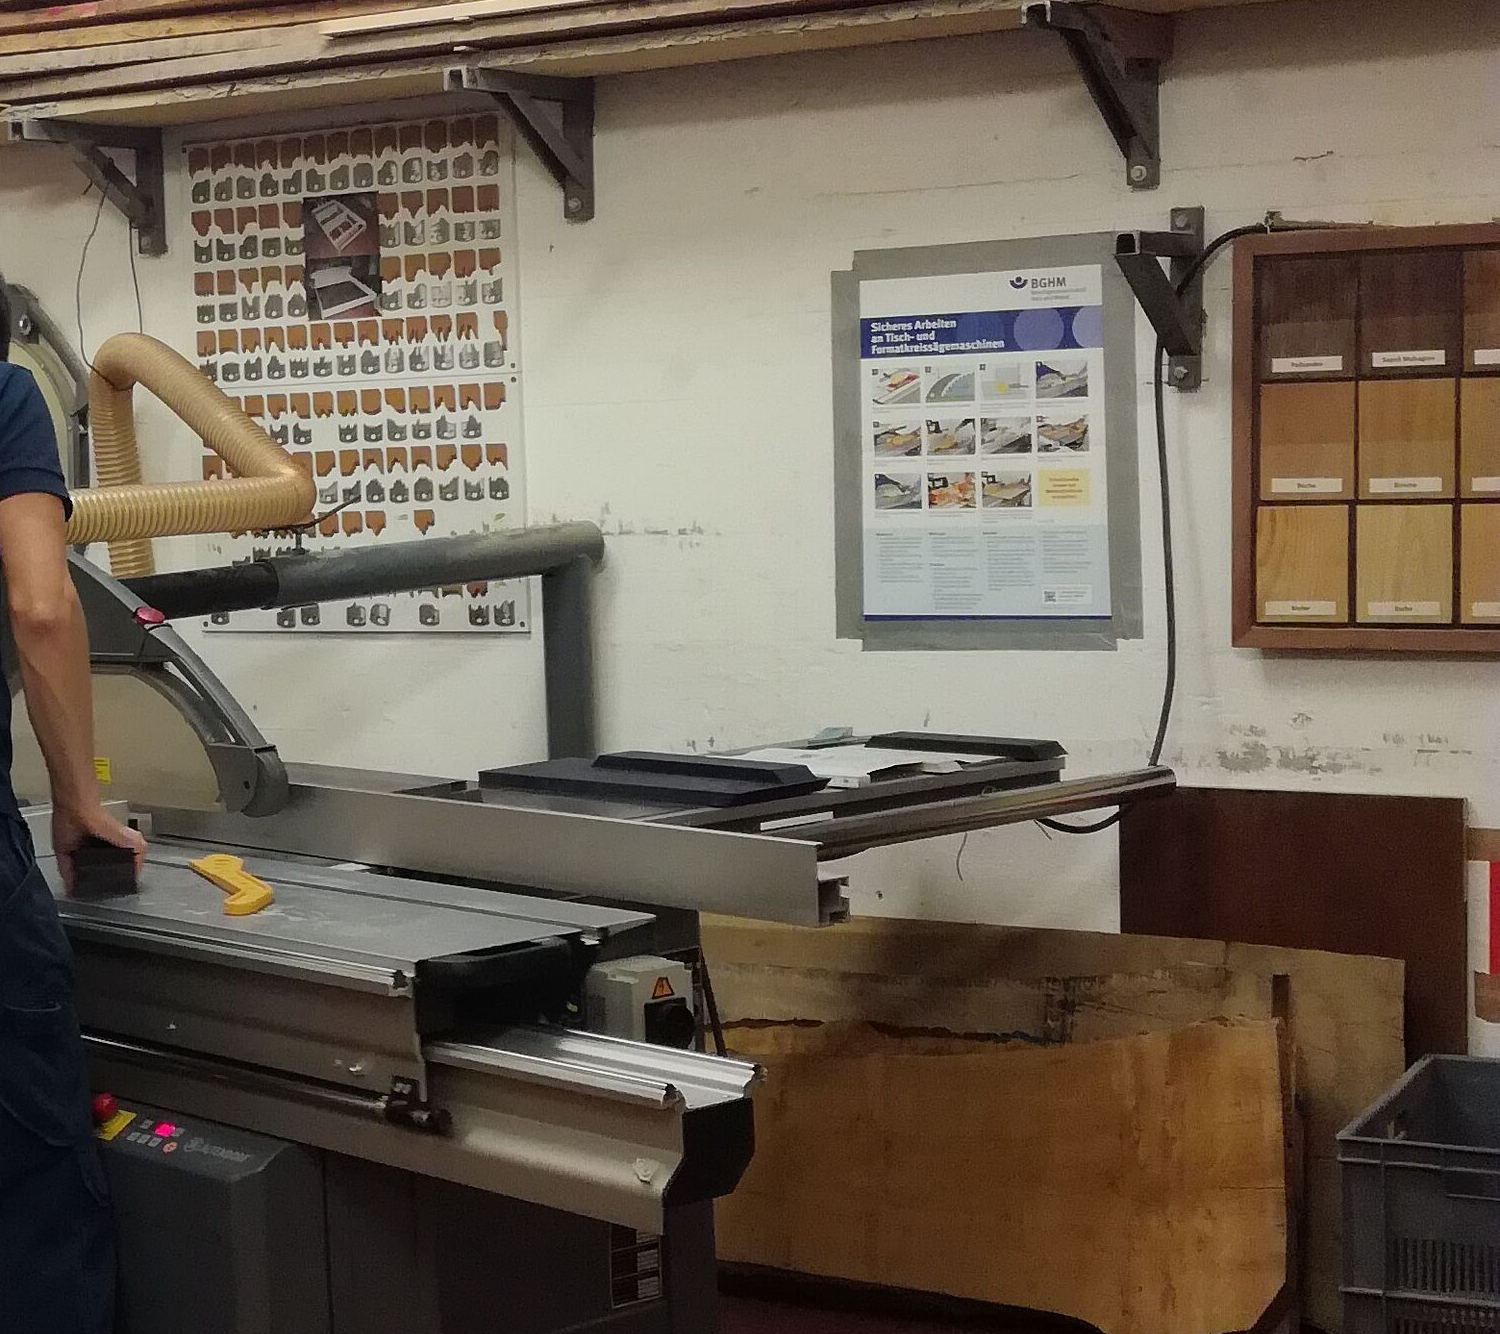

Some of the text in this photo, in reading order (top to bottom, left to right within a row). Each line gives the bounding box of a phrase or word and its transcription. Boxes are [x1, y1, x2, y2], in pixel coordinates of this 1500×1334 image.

[1031, 277, 1067, 289] BGHM
[871, 319, 957, 332] Sicheres Arbeiten
[871, 331, 936, 343] an Tisch- und
[871, 339, 1005, 354] Formatkreissägemaschinen
